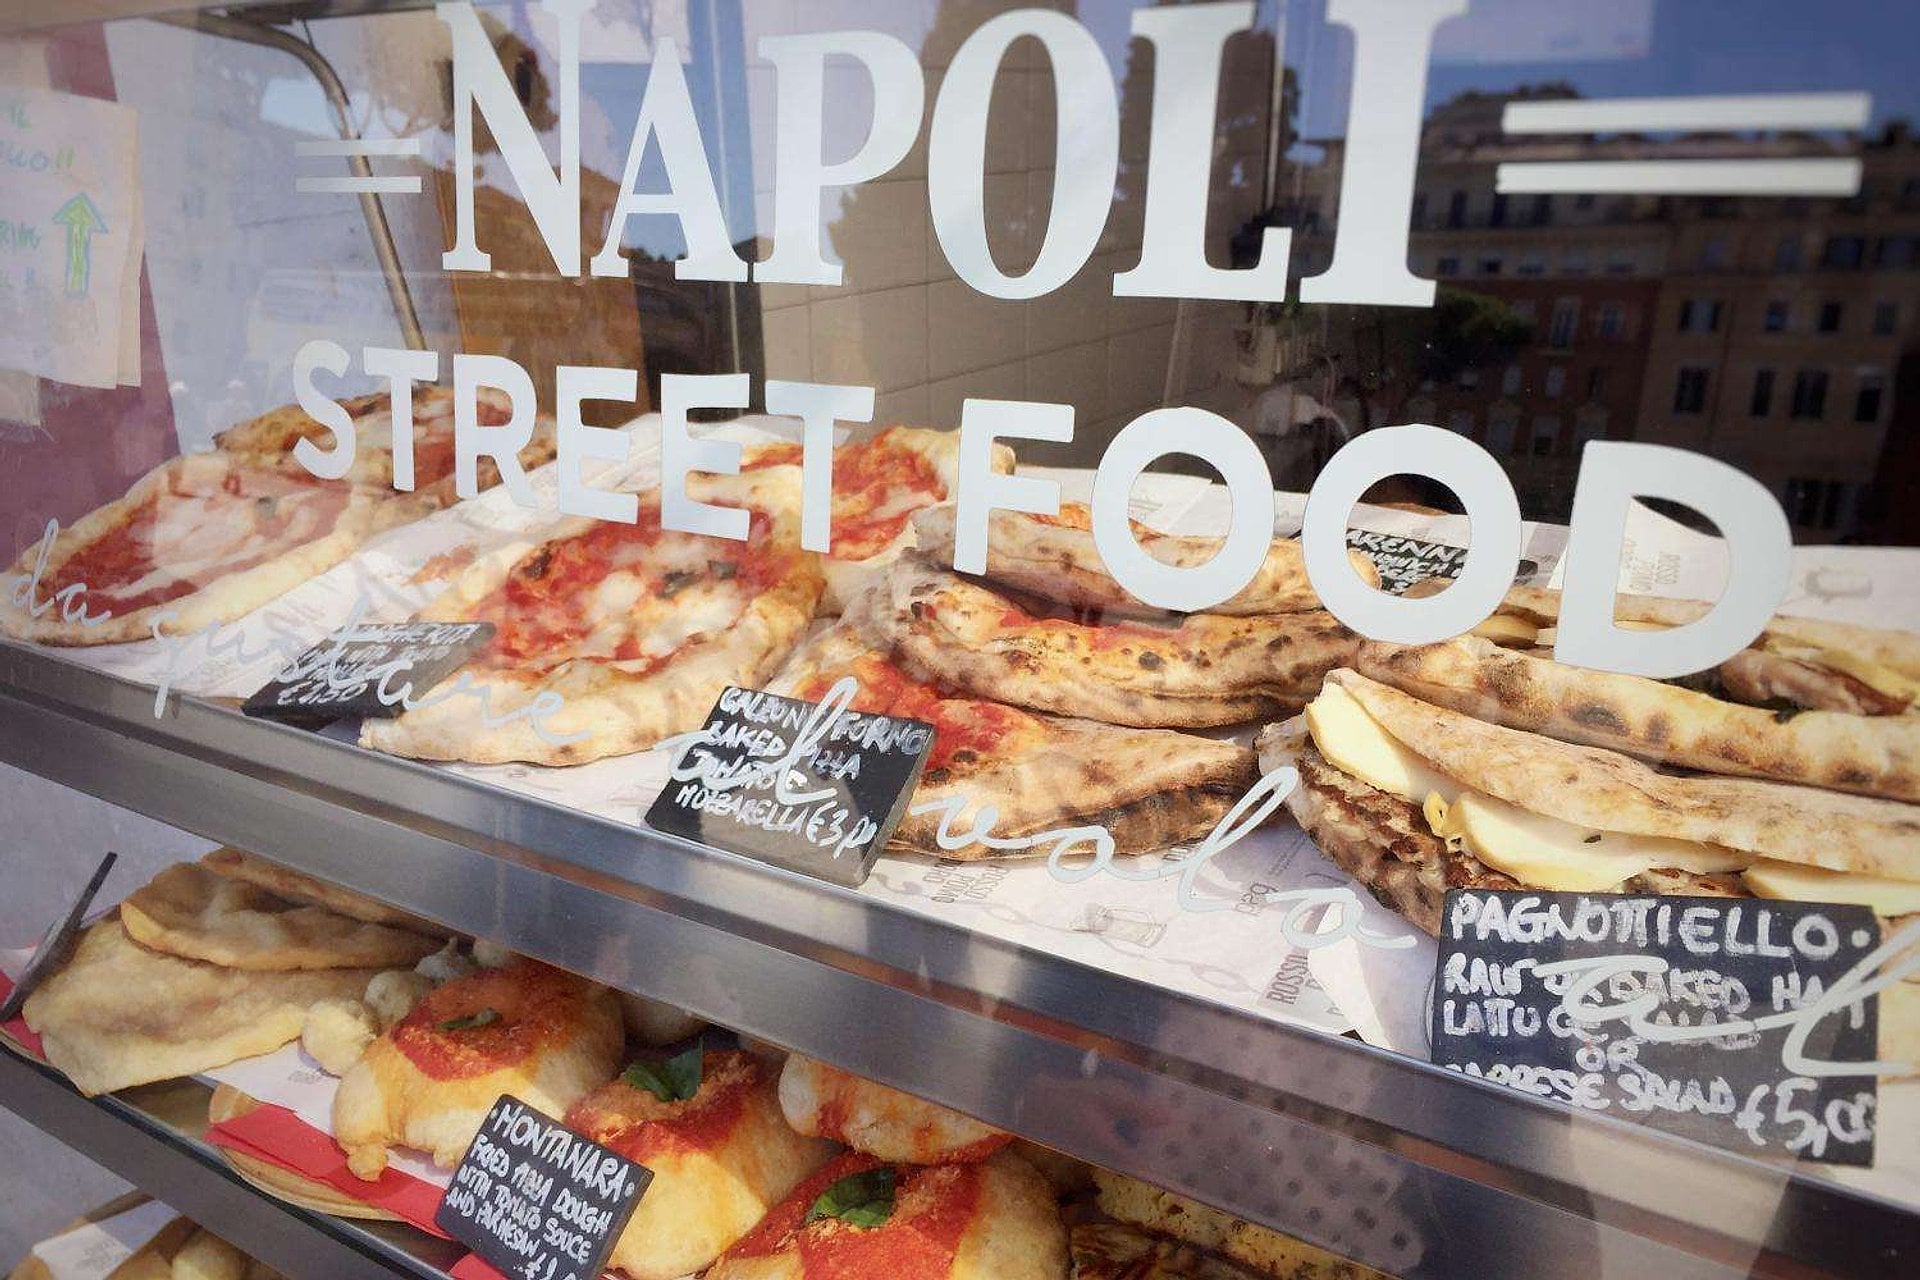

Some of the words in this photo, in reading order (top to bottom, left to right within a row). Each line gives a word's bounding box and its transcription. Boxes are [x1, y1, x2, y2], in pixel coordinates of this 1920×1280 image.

[441, 0, 1468, 307] NAPOLI
[292, 340, 875, 554] STREET
[953, 397, 1794, 679] FOOD
[1575, 1036, 1640, 1074] OR
